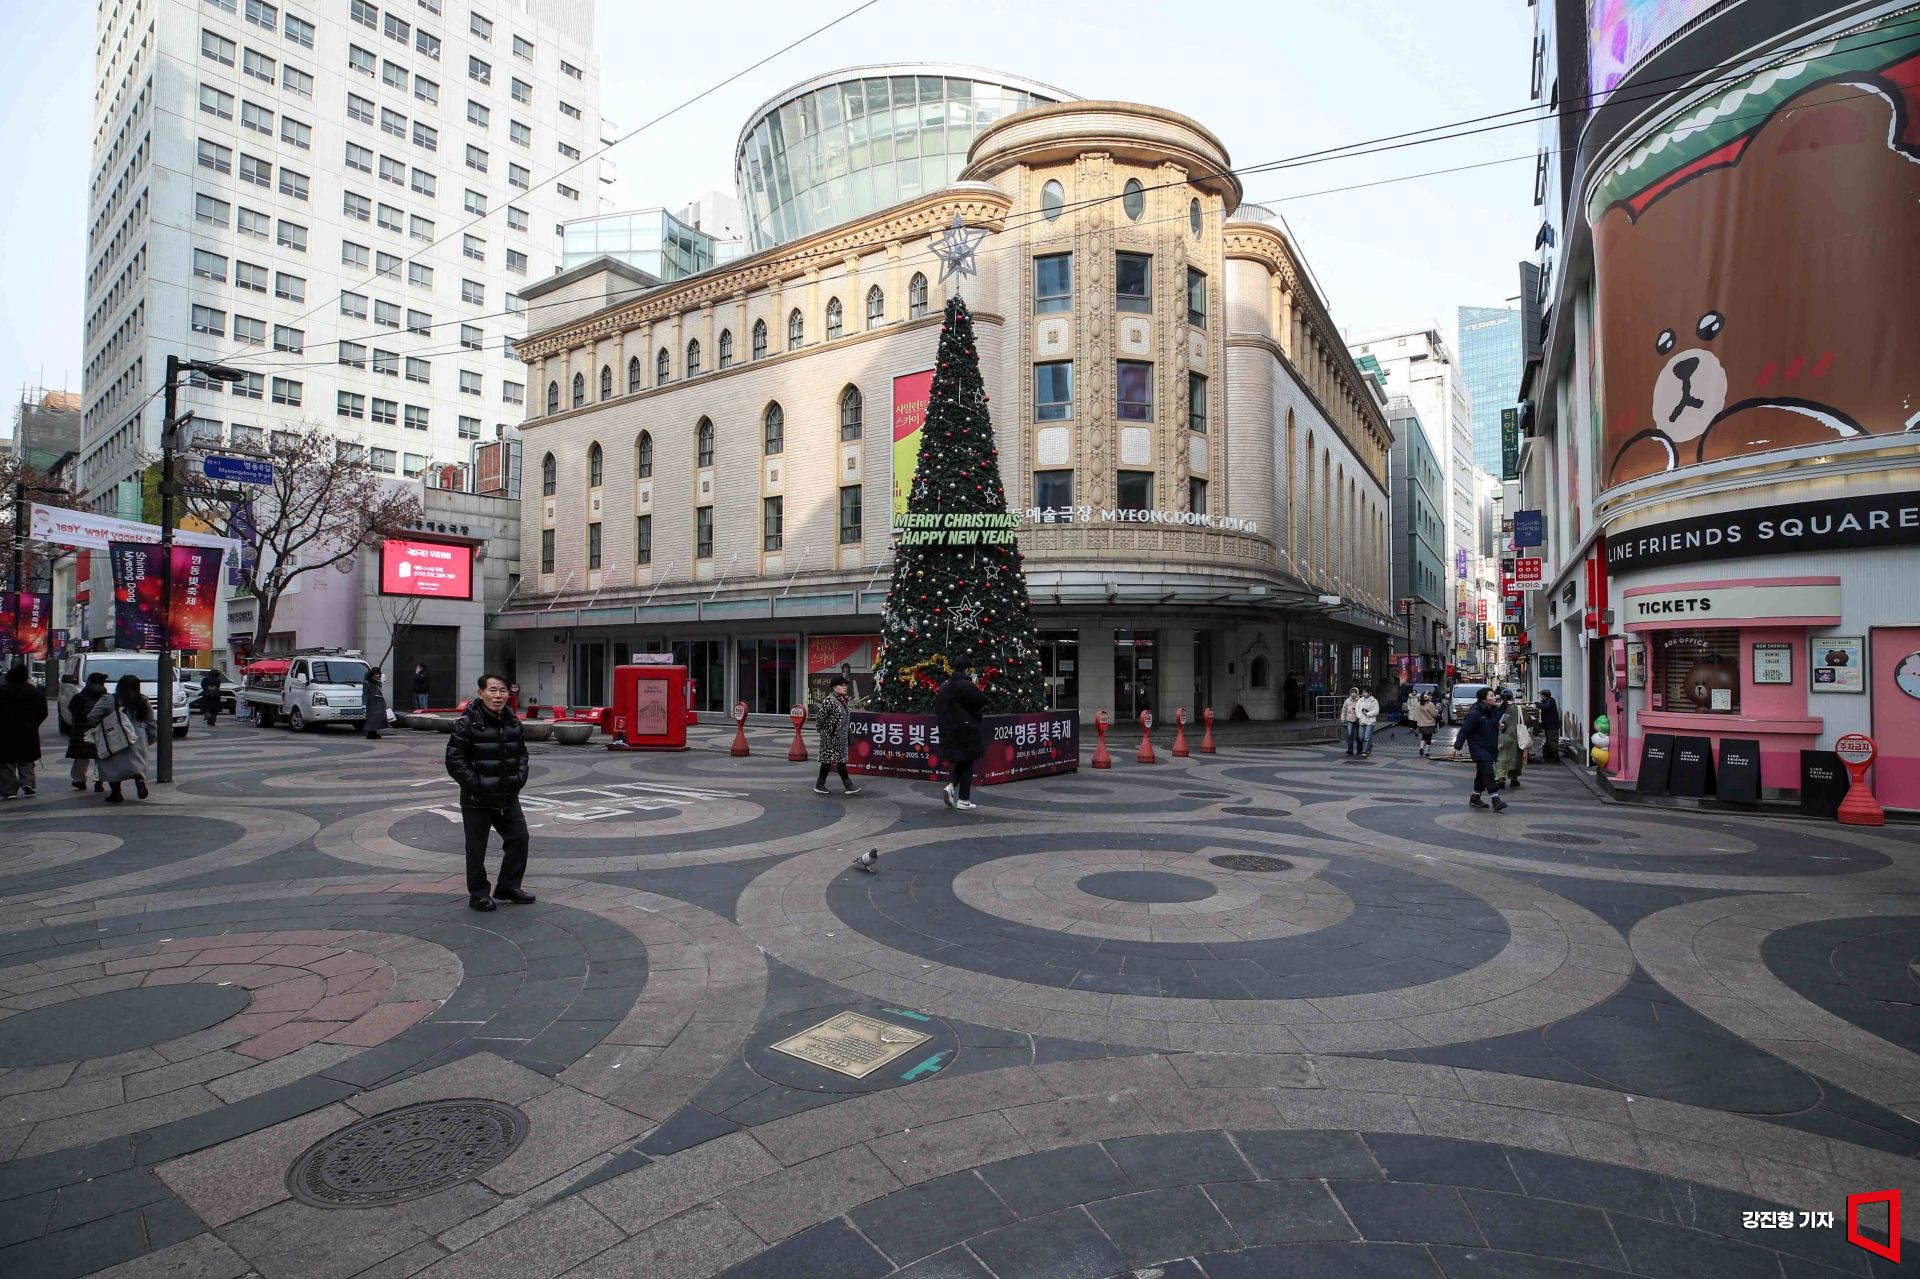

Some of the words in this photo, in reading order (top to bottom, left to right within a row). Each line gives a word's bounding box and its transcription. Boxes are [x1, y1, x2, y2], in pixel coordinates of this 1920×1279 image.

[1465, 317, 1509, 331] FERRUM
[895, 400, 928, 415] 사일런트
[895, 413, 920, 427] 스카이
[218, 467, 257, 478] Myeongdong
[243, 462, 271, 473] 명동8길
[894, 513, 943, 528] MERRY
[944, 513, 1021, 528] CHRISTMAS
[1101, 508, 1214, 528] MYEONGDONG
[901, 531, 947, 545] HAPPY
[948, 531, 980, 545] NEW
[980, 531, 1015, 545] YEAR
[1608, 542, 1633, 563] LINE
[1639, 525, 1743, 556] FRIENDS
[1758, 507, 1920, 540] SQUARE
[124, 550, 134, 581] Myeong
[136, 551, 147, 580] Shining
[126, 582, 136, 603] Dong
[1638, 598, 1712, 615] TICKETS
[1664, 640, 1677, 648] BOX
[1679, 638, 1709, 648] OFFICE
[810, 651, 835, 665] 스카이
[849, 721, 869, 735] 024
[871, 723, 904, 745] 명동
[909, 724, 925, 747] 빛
[994, 726, 1013, 741] 2024
[1014, 723, 1037, 746] 명동
[1039, 721, 1050, 742] 빛
[1051, 719, 1071, 741] 축제
[1840, 742, 1869, 751] 주차금지
